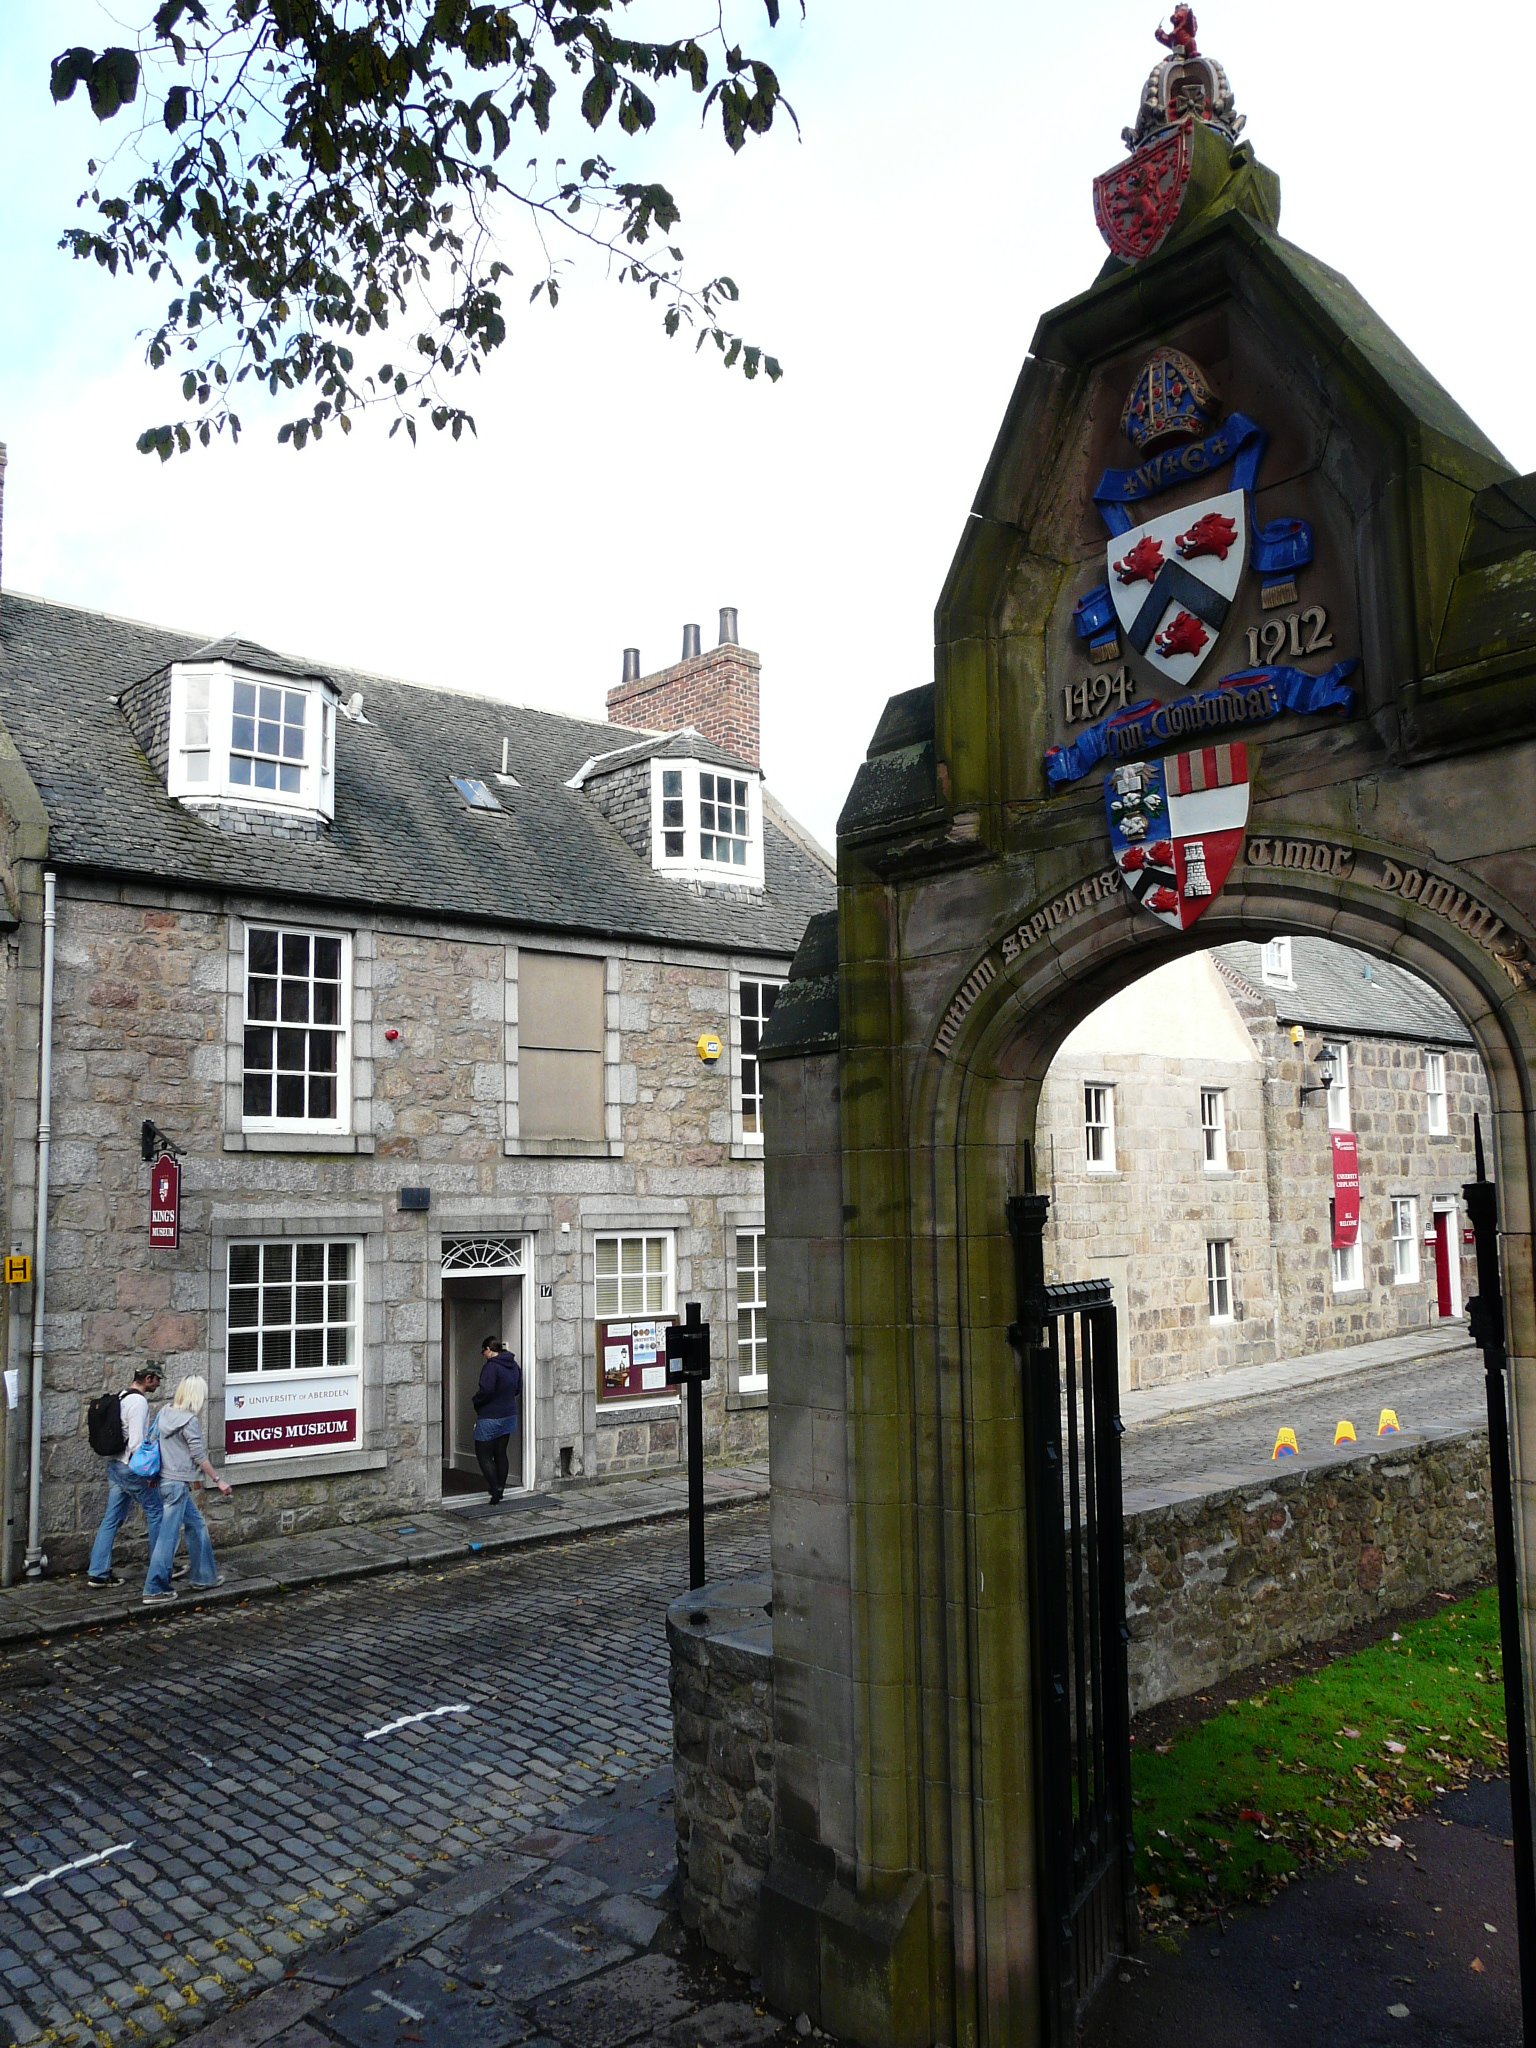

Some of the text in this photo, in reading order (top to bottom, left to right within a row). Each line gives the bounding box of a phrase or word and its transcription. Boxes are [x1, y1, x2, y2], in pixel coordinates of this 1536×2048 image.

[1246, 605, 1334, 668] 1912
[1062, 665, 1135, 724] 1494
[152, 1210, 175, 1222] KING'S
[151, 1227, 174, 1237] MUSEUM
[9, 1258, 26, 1280] H
[542, 1285, 552, 1297] 17
[249, 1393, 297, 1405] UNIVERSITY
[308, 1389, 349, 1399] ABERDEEN
[233, 1420, 349, 1443] KING'S MUSEUM
